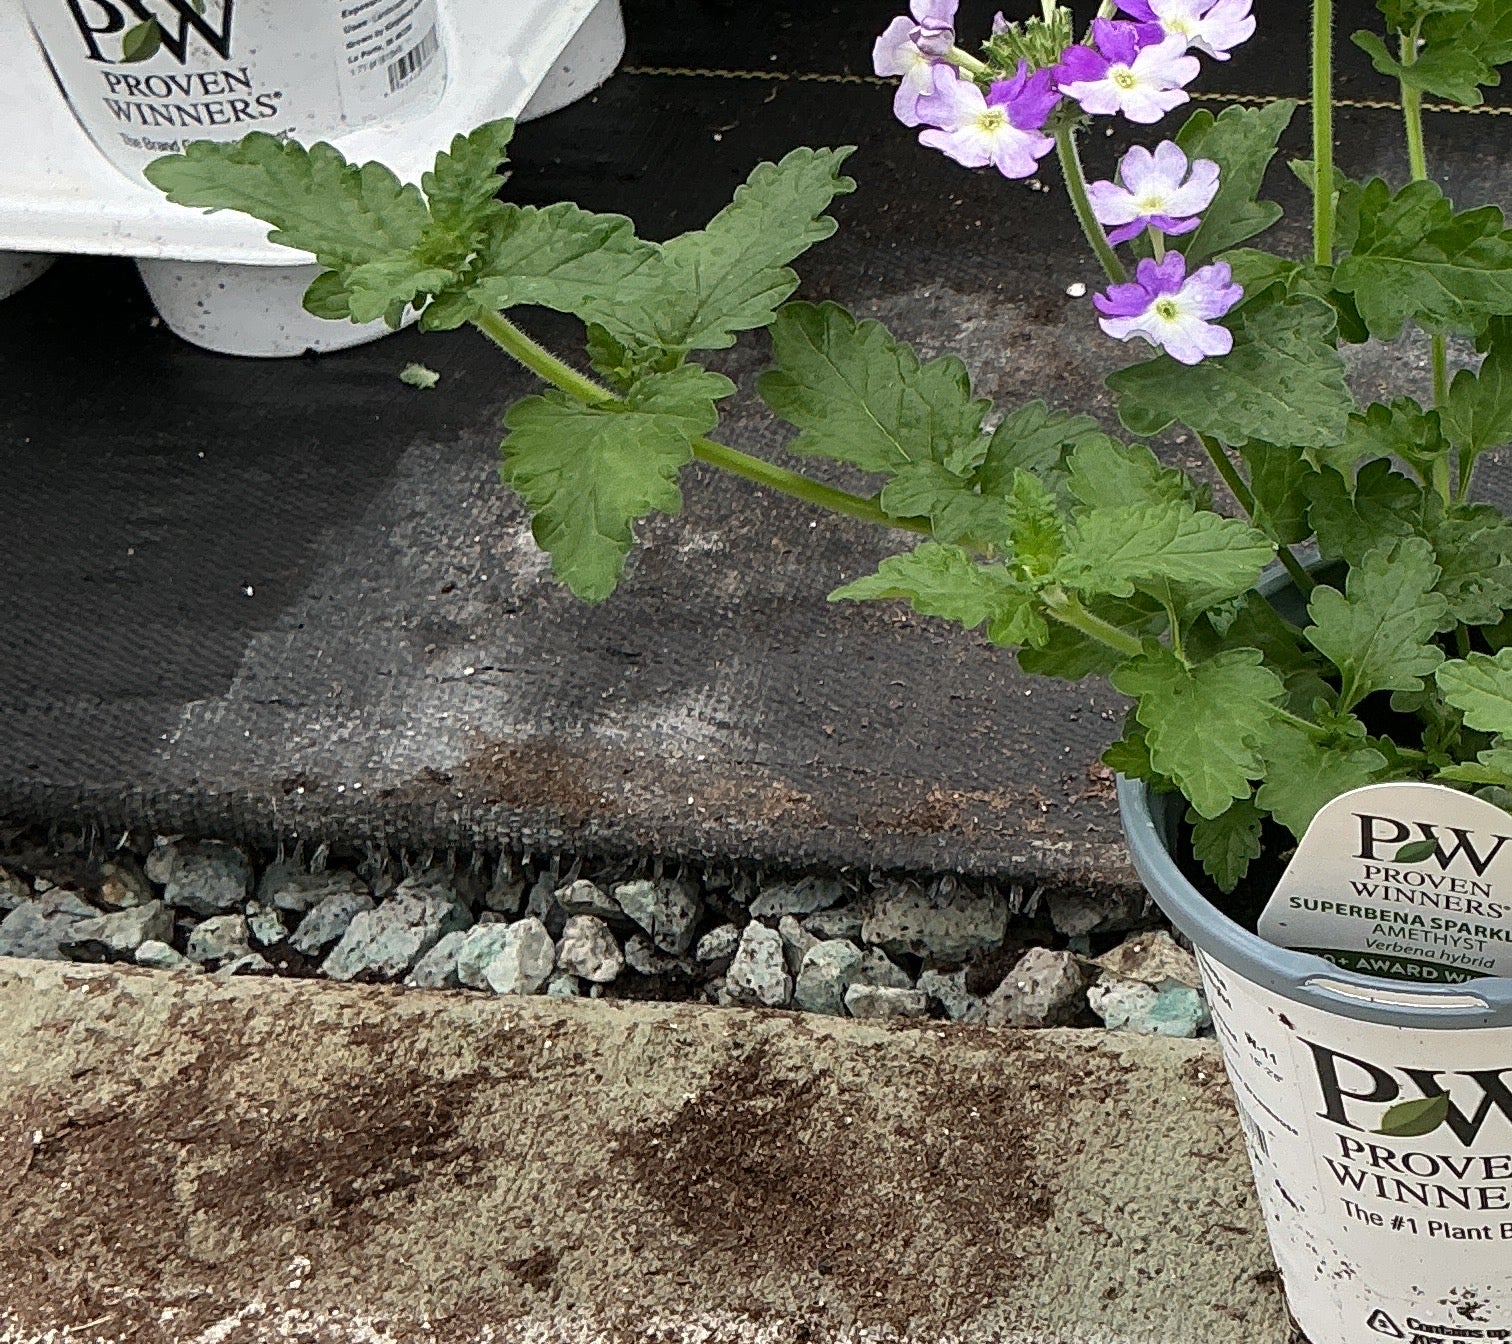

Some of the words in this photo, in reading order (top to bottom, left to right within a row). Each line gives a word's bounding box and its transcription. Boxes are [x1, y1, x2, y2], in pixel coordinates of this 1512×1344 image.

[101, 67, 253, 98] PROVEN
[1351, 812, 1512, 877] PW
[1363, 864, 1493, 899] PROVEN
[1289, 896, 1425, 928] SUPERBENA
[1372, 923, 1488, 952] AMETHYST
[1356, 958, 1438, 980] AWARD
[1365, 938, 1435, 959] Verbena
[1439, 948, 1496, 969] hybrid
[1340, 1197, 1383, 1226] The
[1390, 1215, 1418, 1235] #1
[1427, 1220, 1494, 1240] Plant
[1406, 1317, 1483, 1338] Contains
[1486, 1328, 1512, 1341] up
